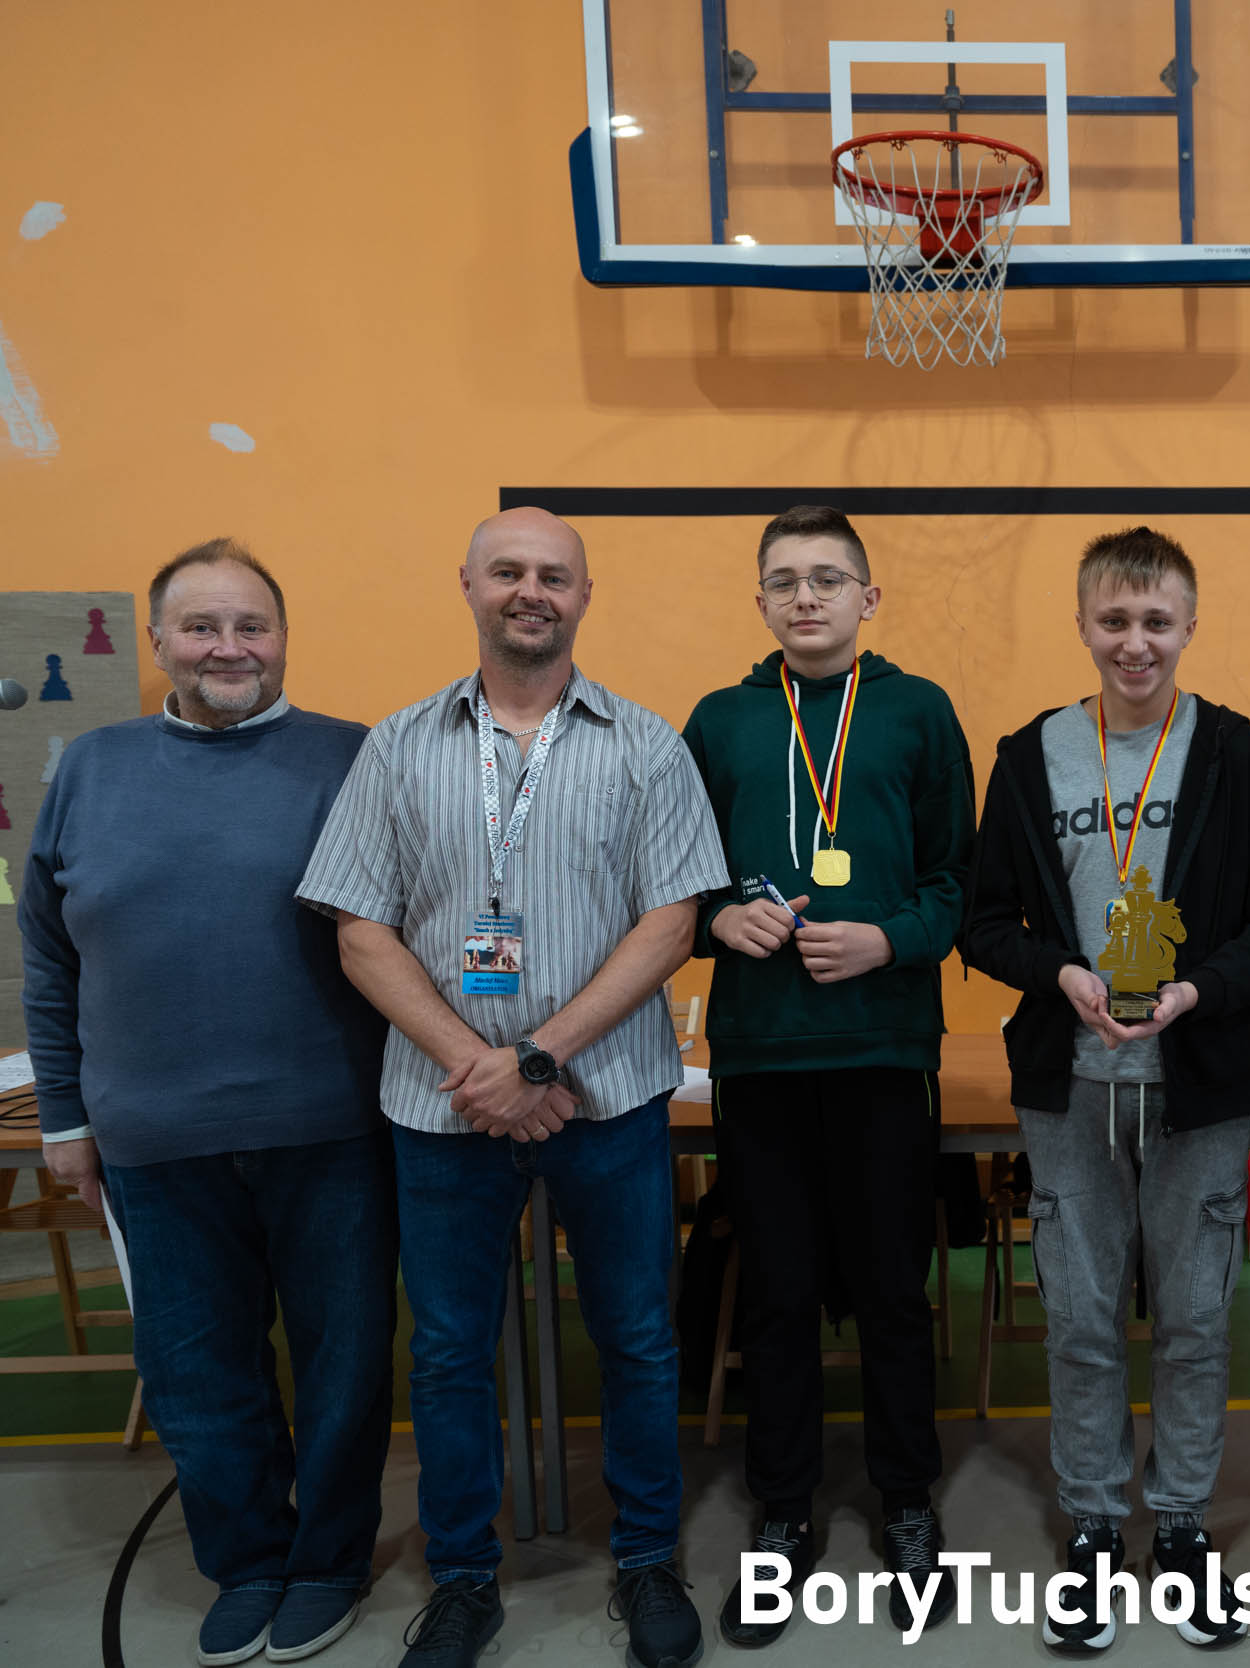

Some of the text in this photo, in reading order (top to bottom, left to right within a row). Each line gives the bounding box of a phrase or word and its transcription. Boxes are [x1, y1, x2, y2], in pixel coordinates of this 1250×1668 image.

[485, 768, 496, 796] CHESS
[527, 761, 540, 787] CHESS
[507, 814, 522, 841] CHESS
[1049, 792, 1176, 839] adida
[491, 824, 500, 851] CHESS
